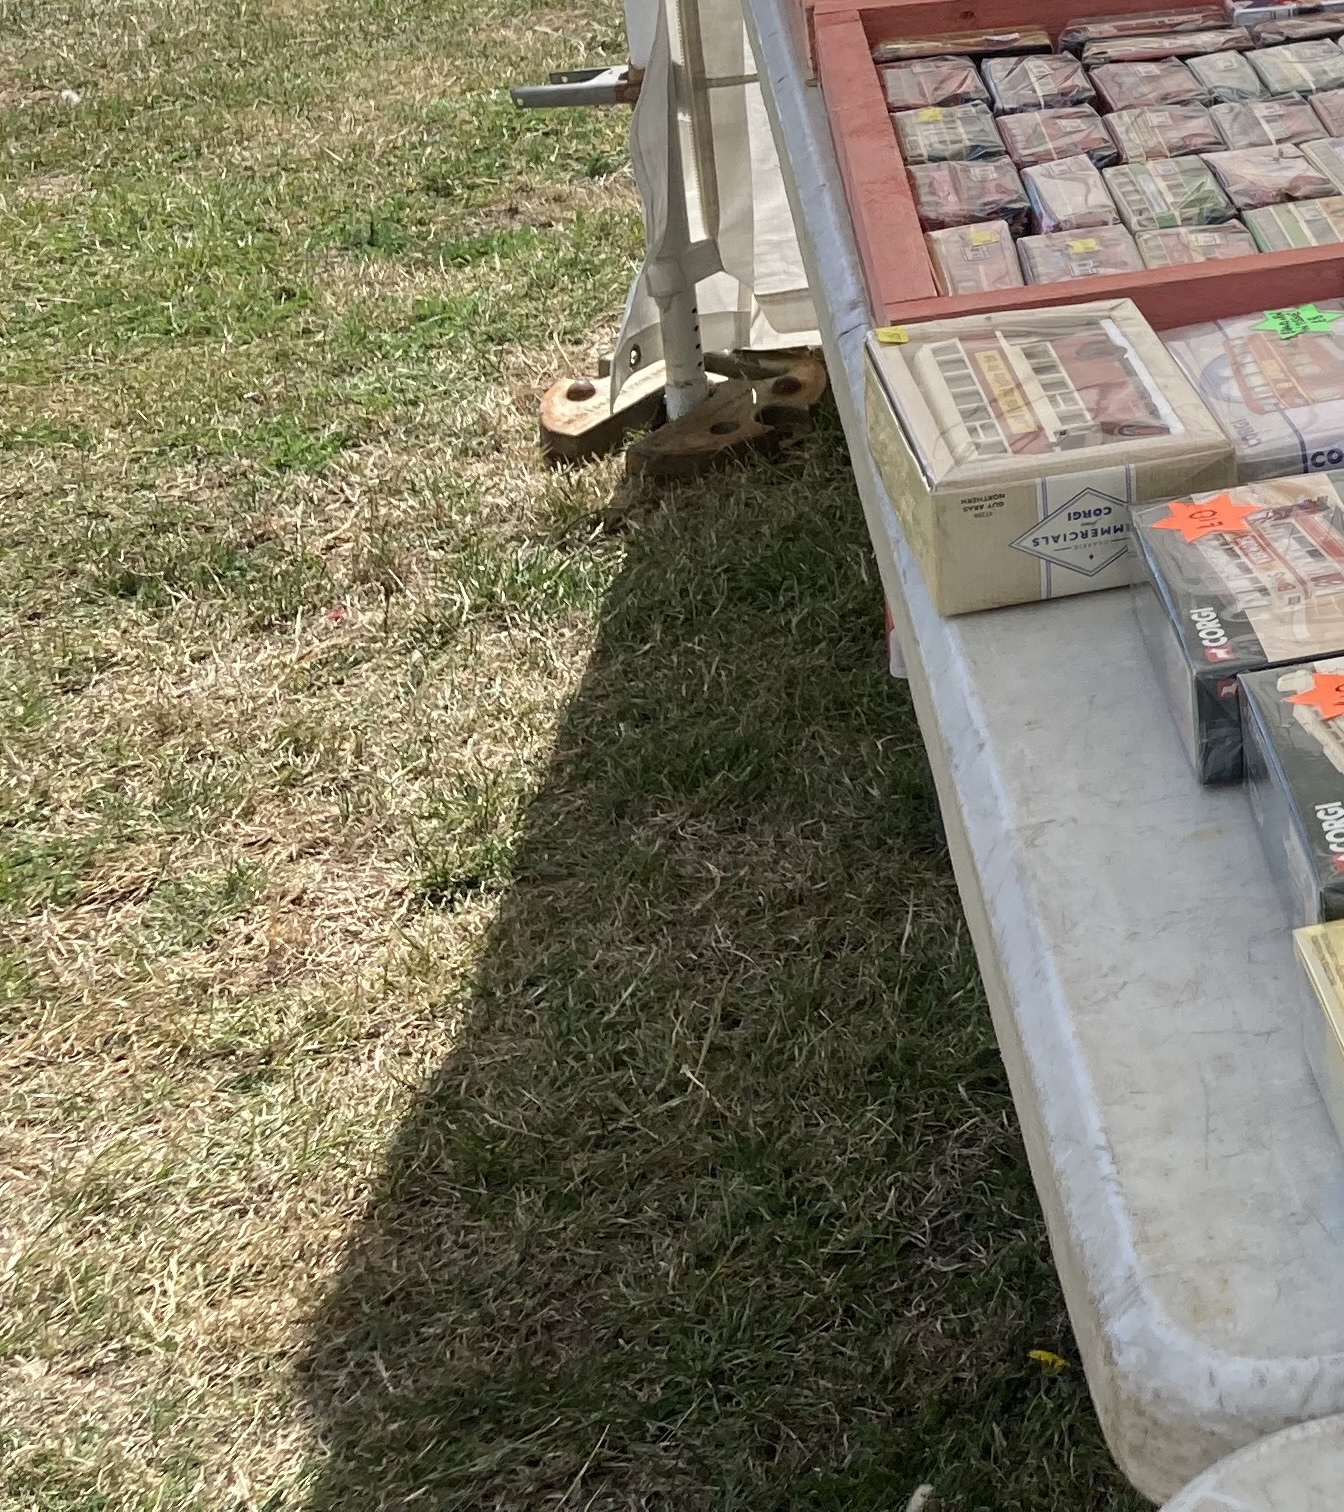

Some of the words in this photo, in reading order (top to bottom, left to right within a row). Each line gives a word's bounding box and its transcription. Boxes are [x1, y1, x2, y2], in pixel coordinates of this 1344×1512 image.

[960, 492, 1006, 505] NORTHERN
[1067, 506, 1112, 522] CORGI
[1187, 509, 1224, 529] £10
[1032, 523, 1132, 547] MMERCIALS
[1189, 606, 1229, 648] CORGI
